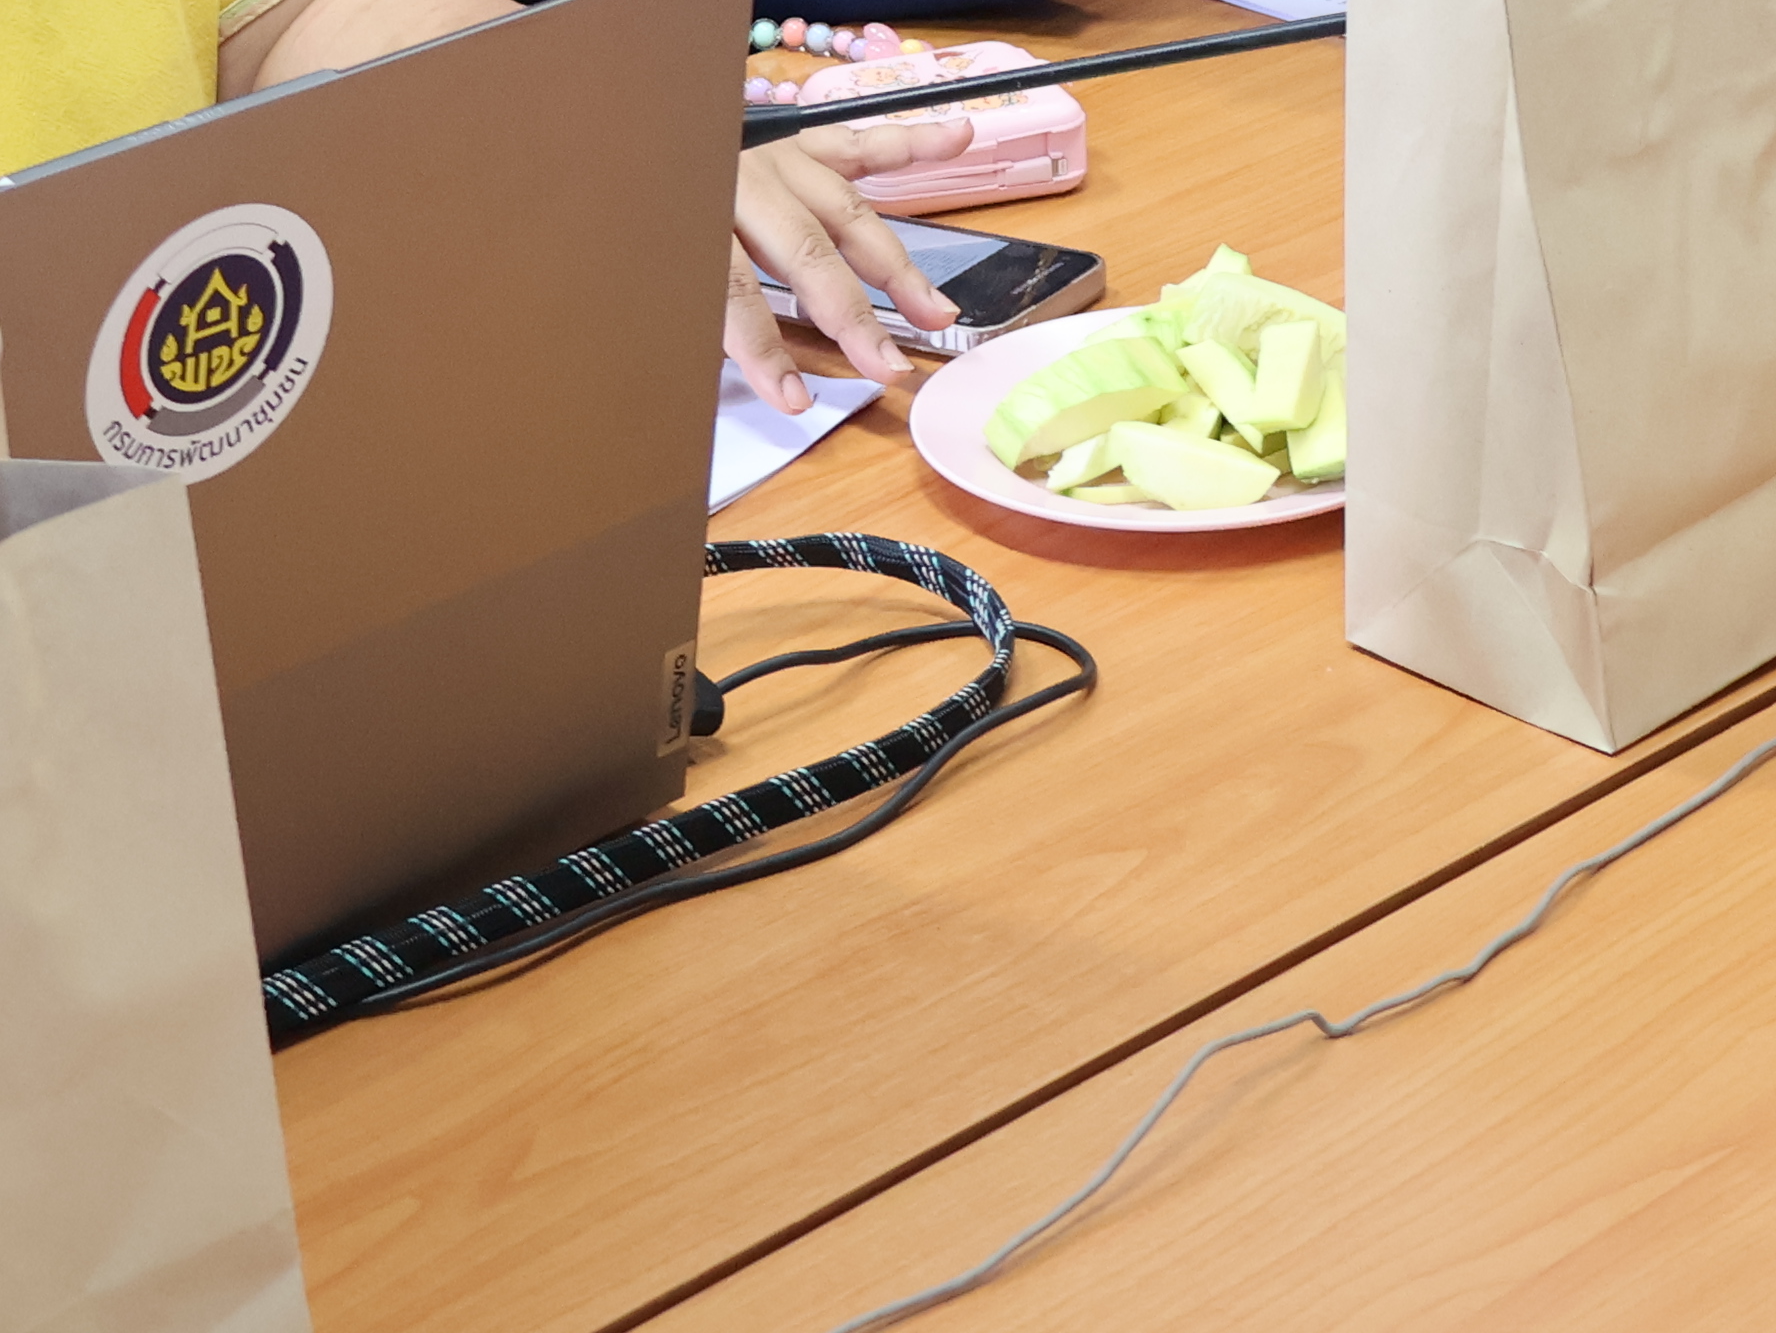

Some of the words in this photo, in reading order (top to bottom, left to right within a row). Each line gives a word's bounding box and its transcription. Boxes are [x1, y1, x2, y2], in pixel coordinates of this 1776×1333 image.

[102, 356, 310, 469] กรมการพัฒนาชุมชน
